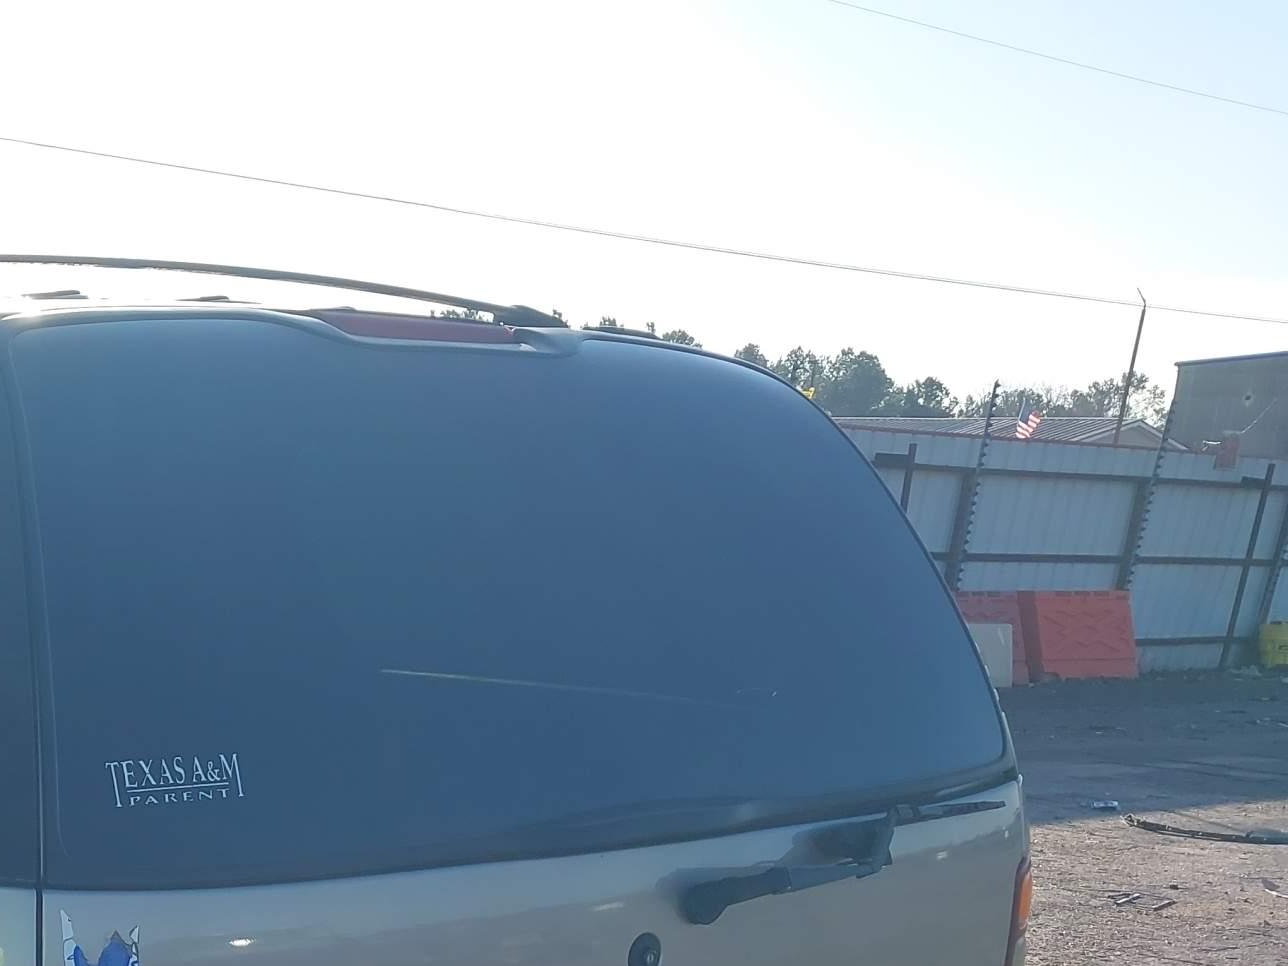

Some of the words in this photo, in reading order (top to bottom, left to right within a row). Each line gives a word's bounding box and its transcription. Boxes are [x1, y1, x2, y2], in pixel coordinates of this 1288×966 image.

[105, 756, 185, 807] TEXAS
[192, 753, 244, 797] A&M
[128, 788, 230, 807] PARENT
